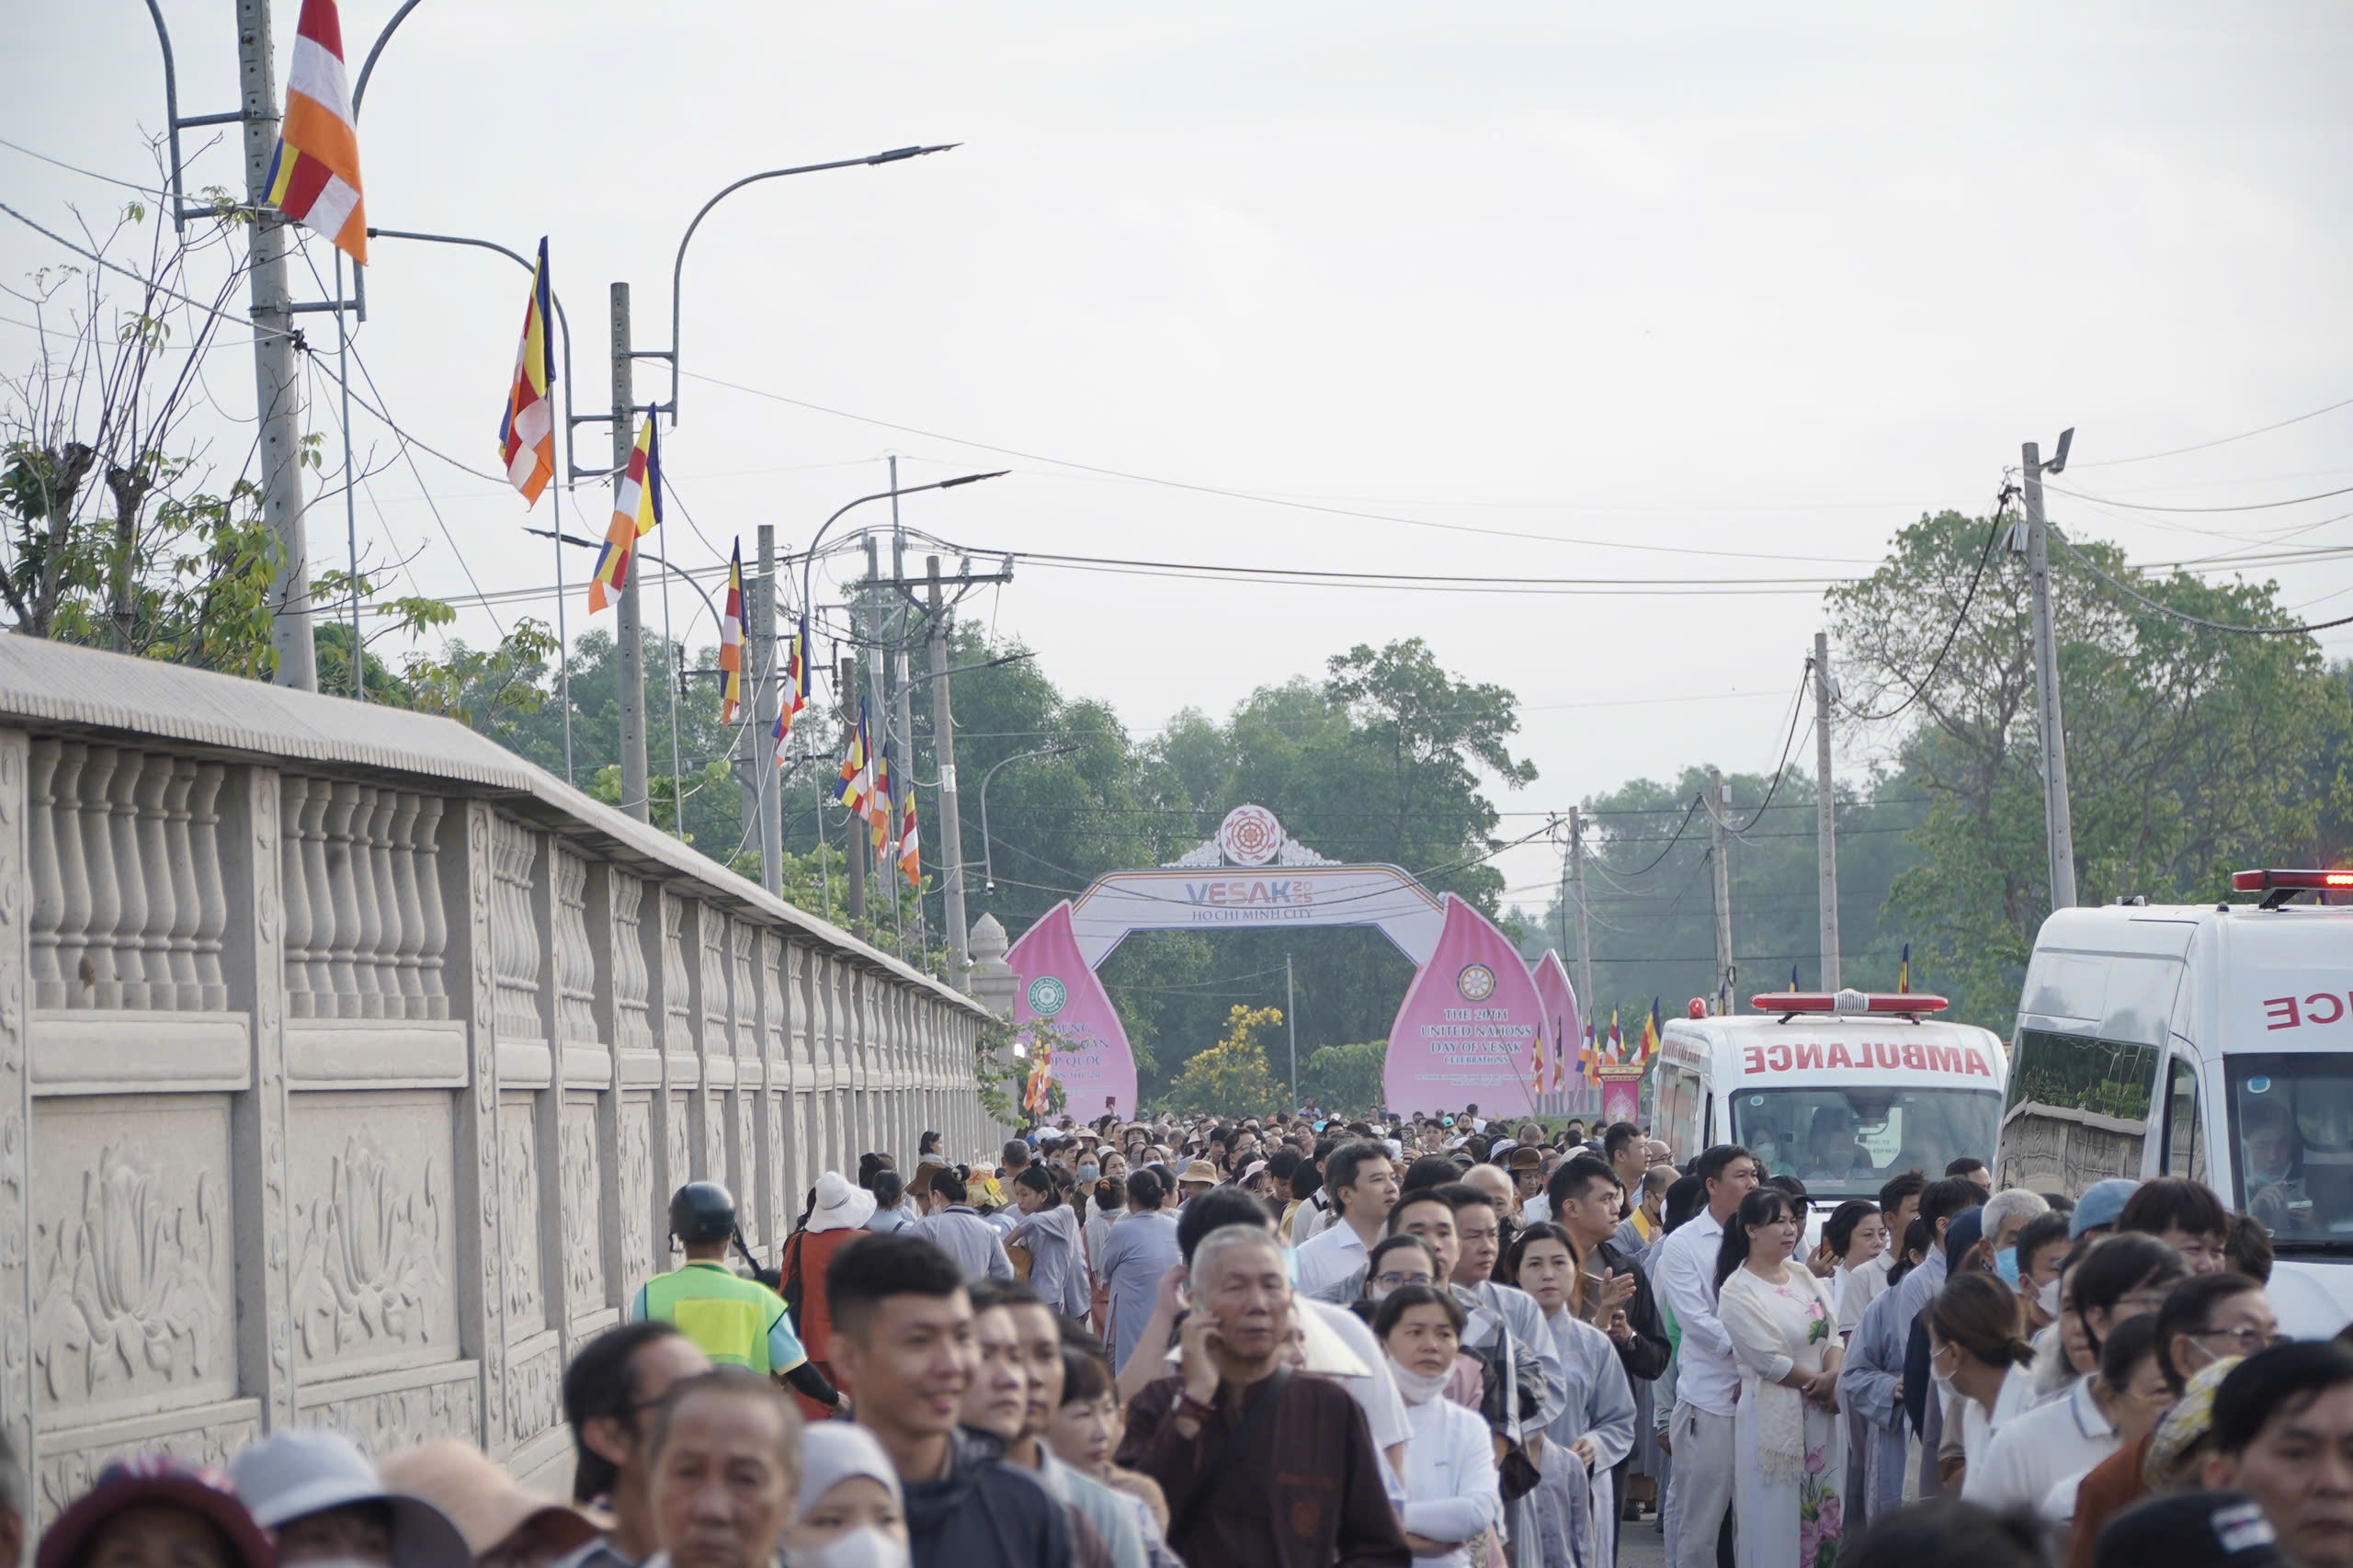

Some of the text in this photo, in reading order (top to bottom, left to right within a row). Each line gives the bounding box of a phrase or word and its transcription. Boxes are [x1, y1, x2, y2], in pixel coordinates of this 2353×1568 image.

[1185, 881, 1291, 905] VESAK
[1193, 908, 1312, 920] HO CHI MINH CITY
[1445, 1008, 1508, 1021] THE 20TH
[1421, 1025, 1532, 1037] UNITED NATIONS
[1431, 1041, 1522, 1053] DAY OF VESAK
[1444, 1056, 1508, 1064] CELEBRATIONS
